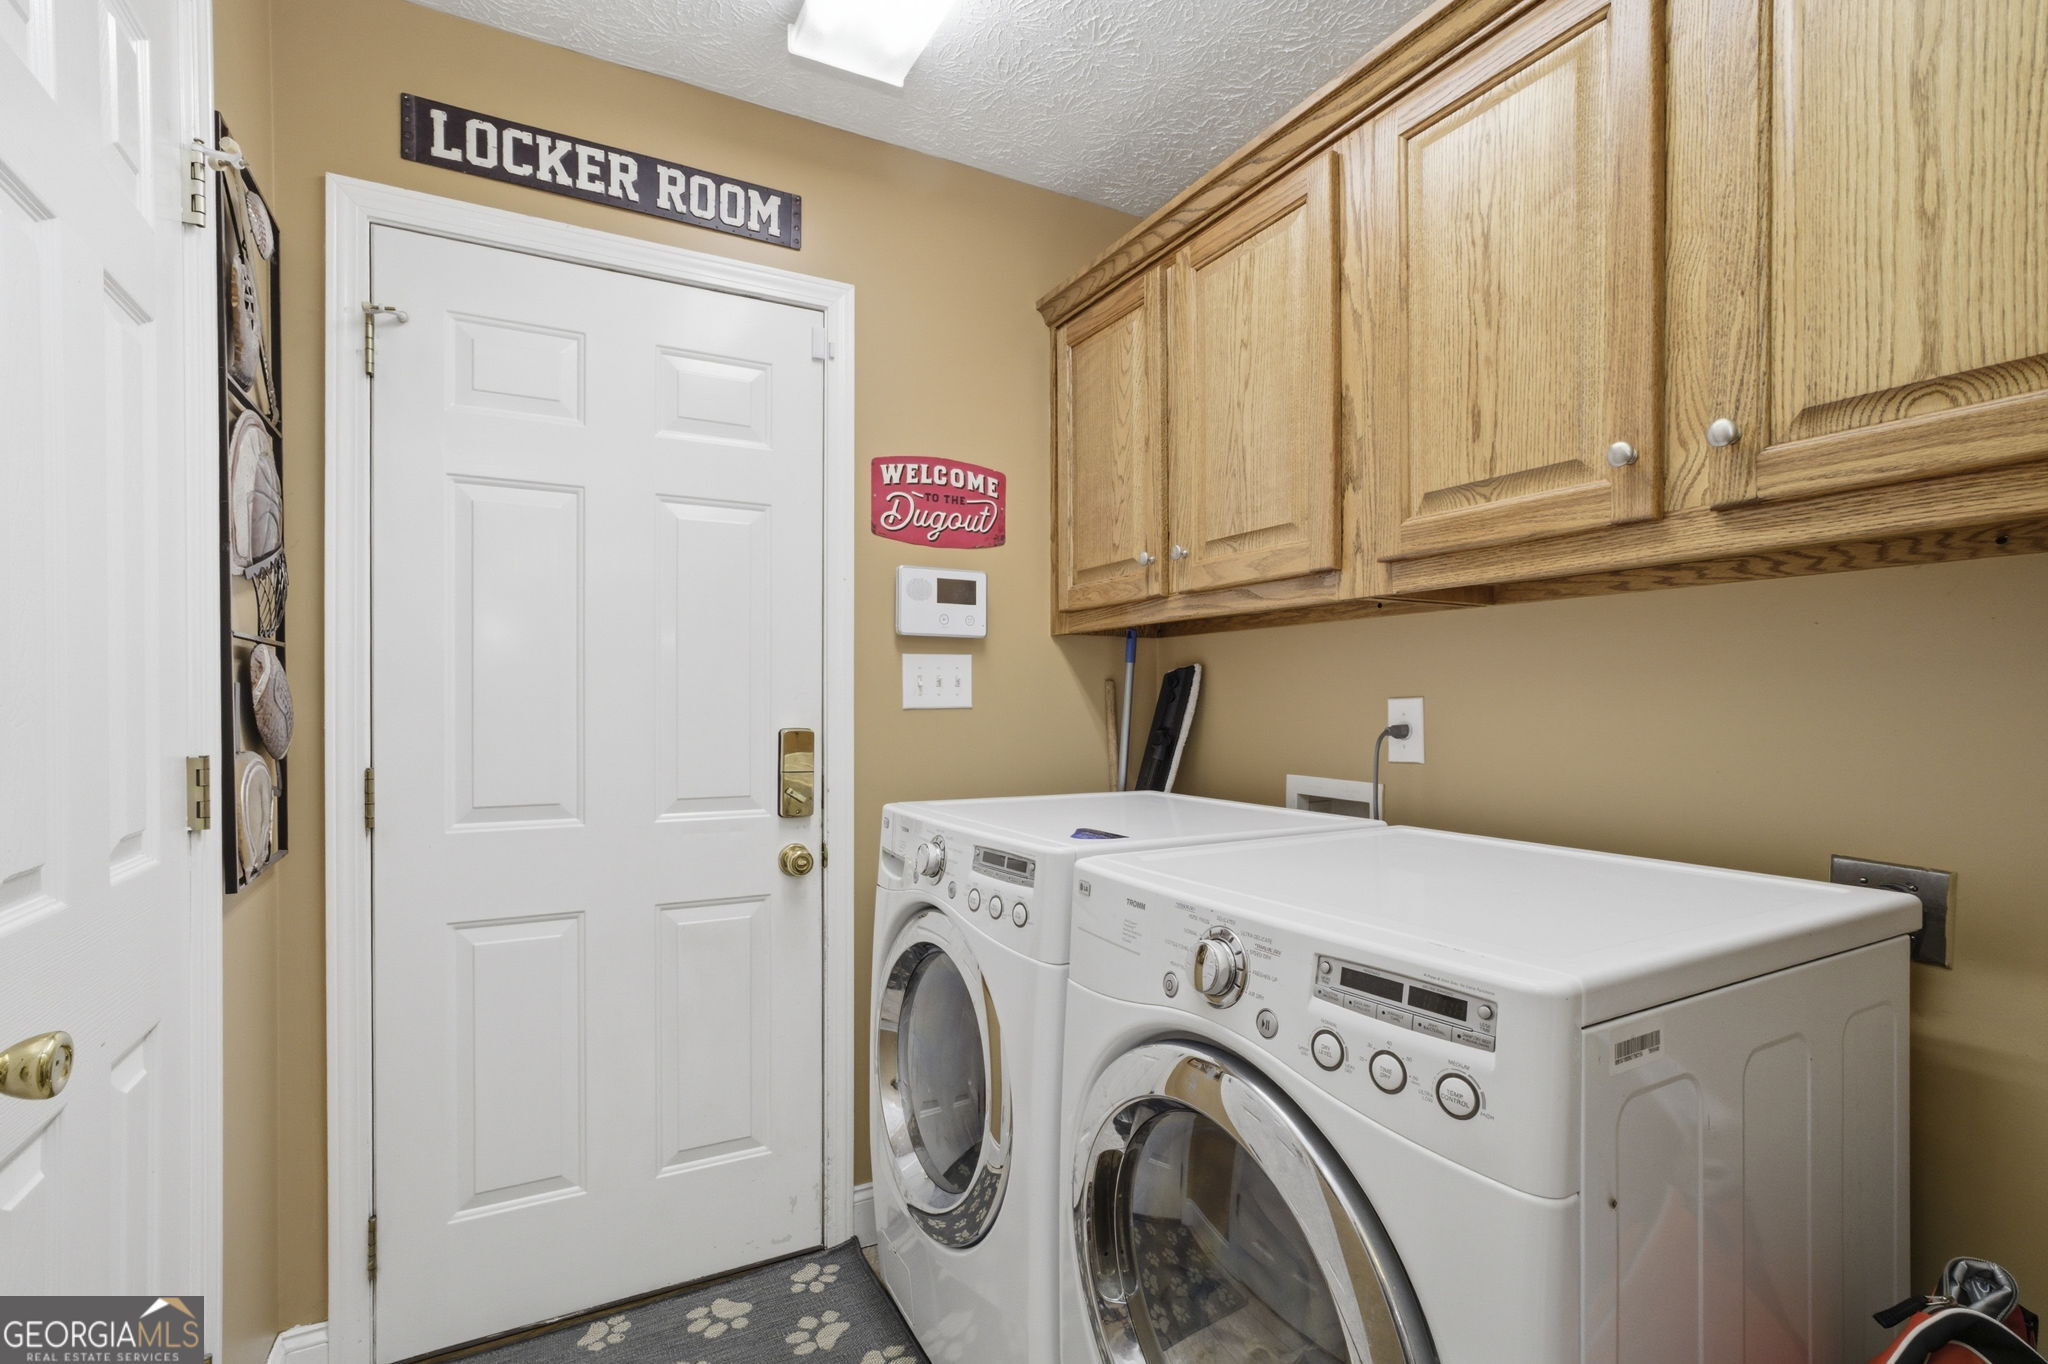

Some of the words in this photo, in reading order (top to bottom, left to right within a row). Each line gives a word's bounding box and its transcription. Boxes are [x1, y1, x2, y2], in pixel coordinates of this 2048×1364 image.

[430, 108, 640, 203] LOCKER
[656, 164, 782, 238] ROOM
[880, 463, 999, 499] WELCOME
[925, 492, 940, 503] TO
[943, 494, 967, 506] THE
[880, 491, 998, 541] Dugout
[1126, 897, 1146, 911] TROMM
[1440, 1092, 1471, 1110] CONTROL
